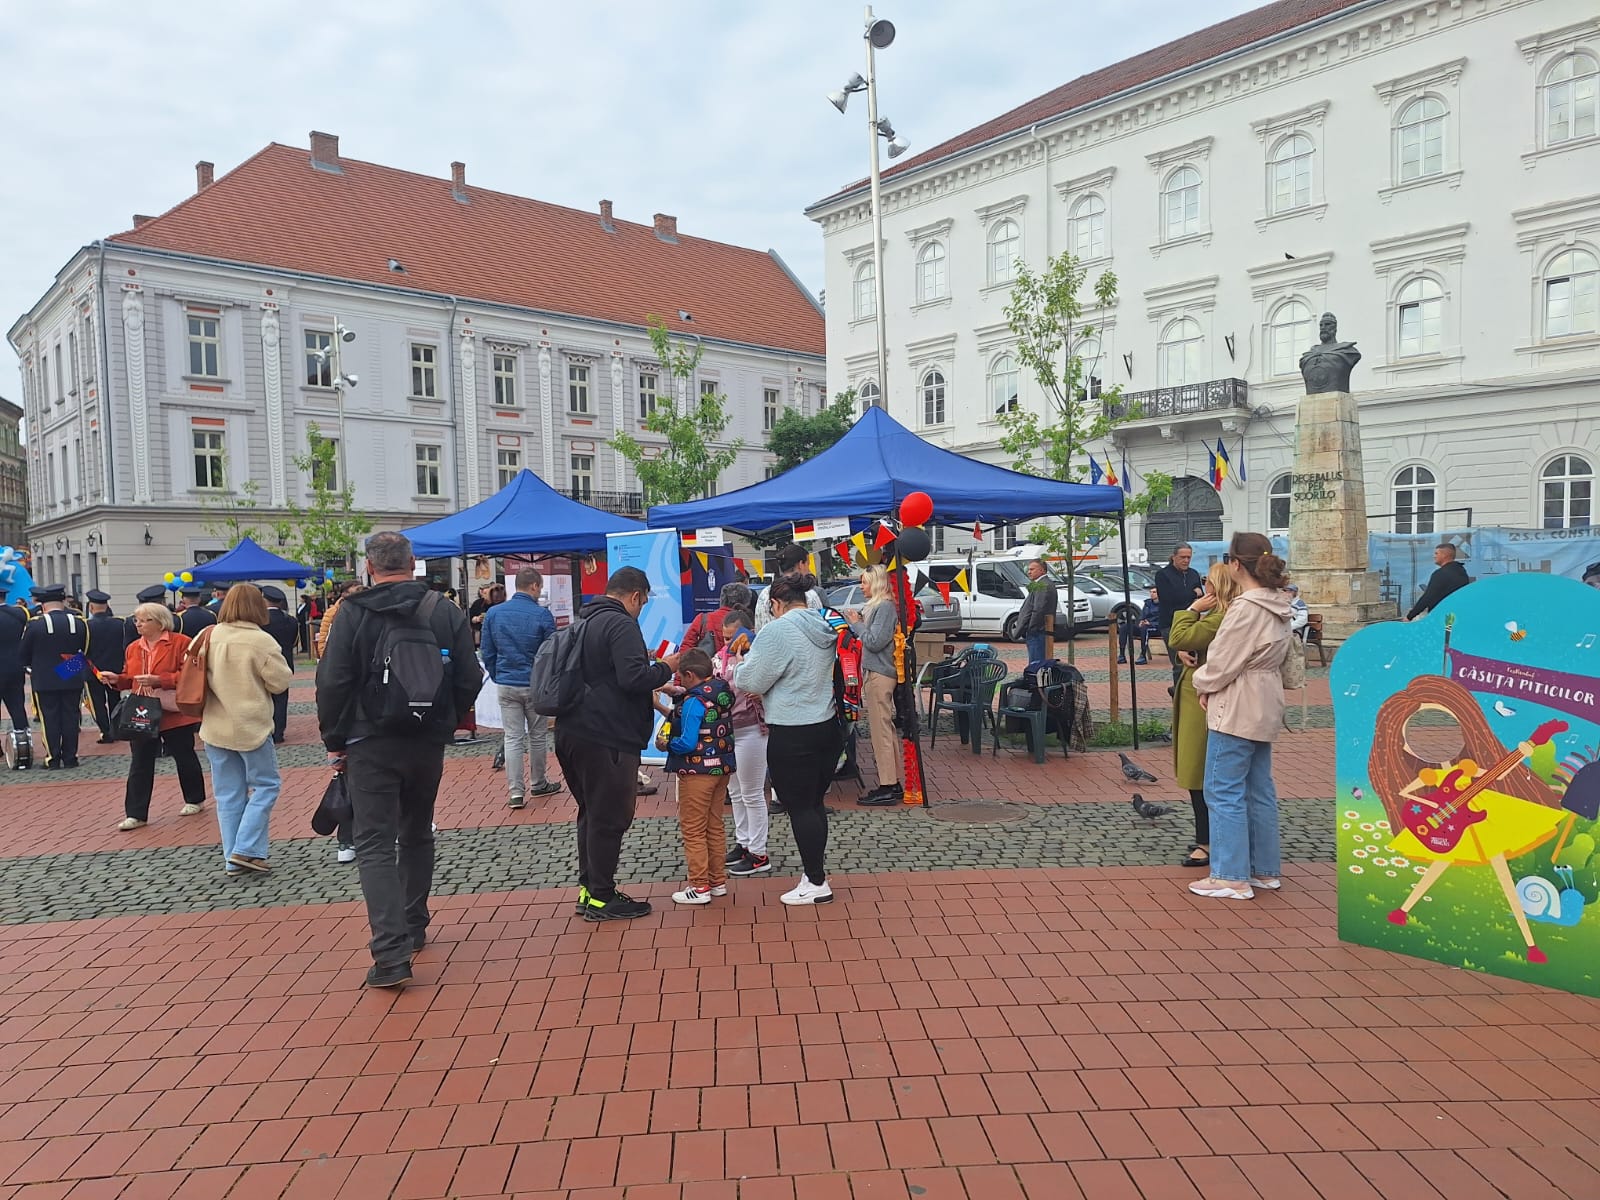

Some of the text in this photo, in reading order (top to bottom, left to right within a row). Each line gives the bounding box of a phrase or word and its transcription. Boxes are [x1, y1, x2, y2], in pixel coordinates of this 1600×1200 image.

[1292, 472, 1343, 484] DECEBALUS
[1308, 481, 1324, 491] PER
[1522, 532, 1545, 541] S.C.
[1519, 679, 1595, 705] PITICILOR
